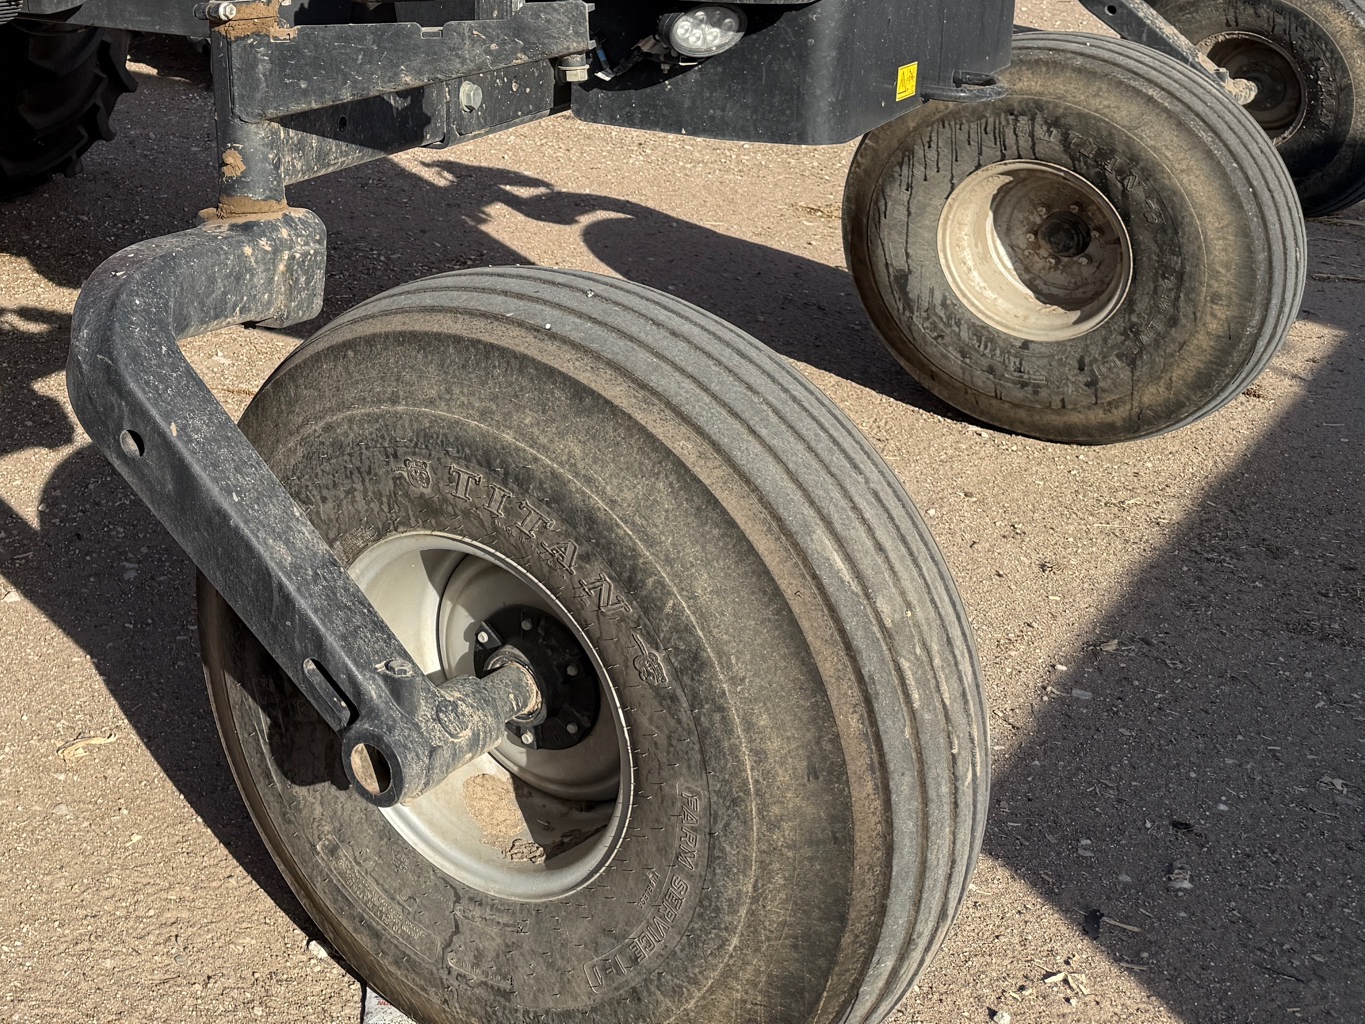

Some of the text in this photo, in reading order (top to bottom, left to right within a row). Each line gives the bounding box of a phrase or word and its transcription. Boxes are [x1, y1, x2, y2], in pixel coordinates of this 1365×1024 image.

[447, 463, 633, 614] TITAN
[677, 792, 701, 872] FARM
[628, 873, 691, 963] SERVICE
